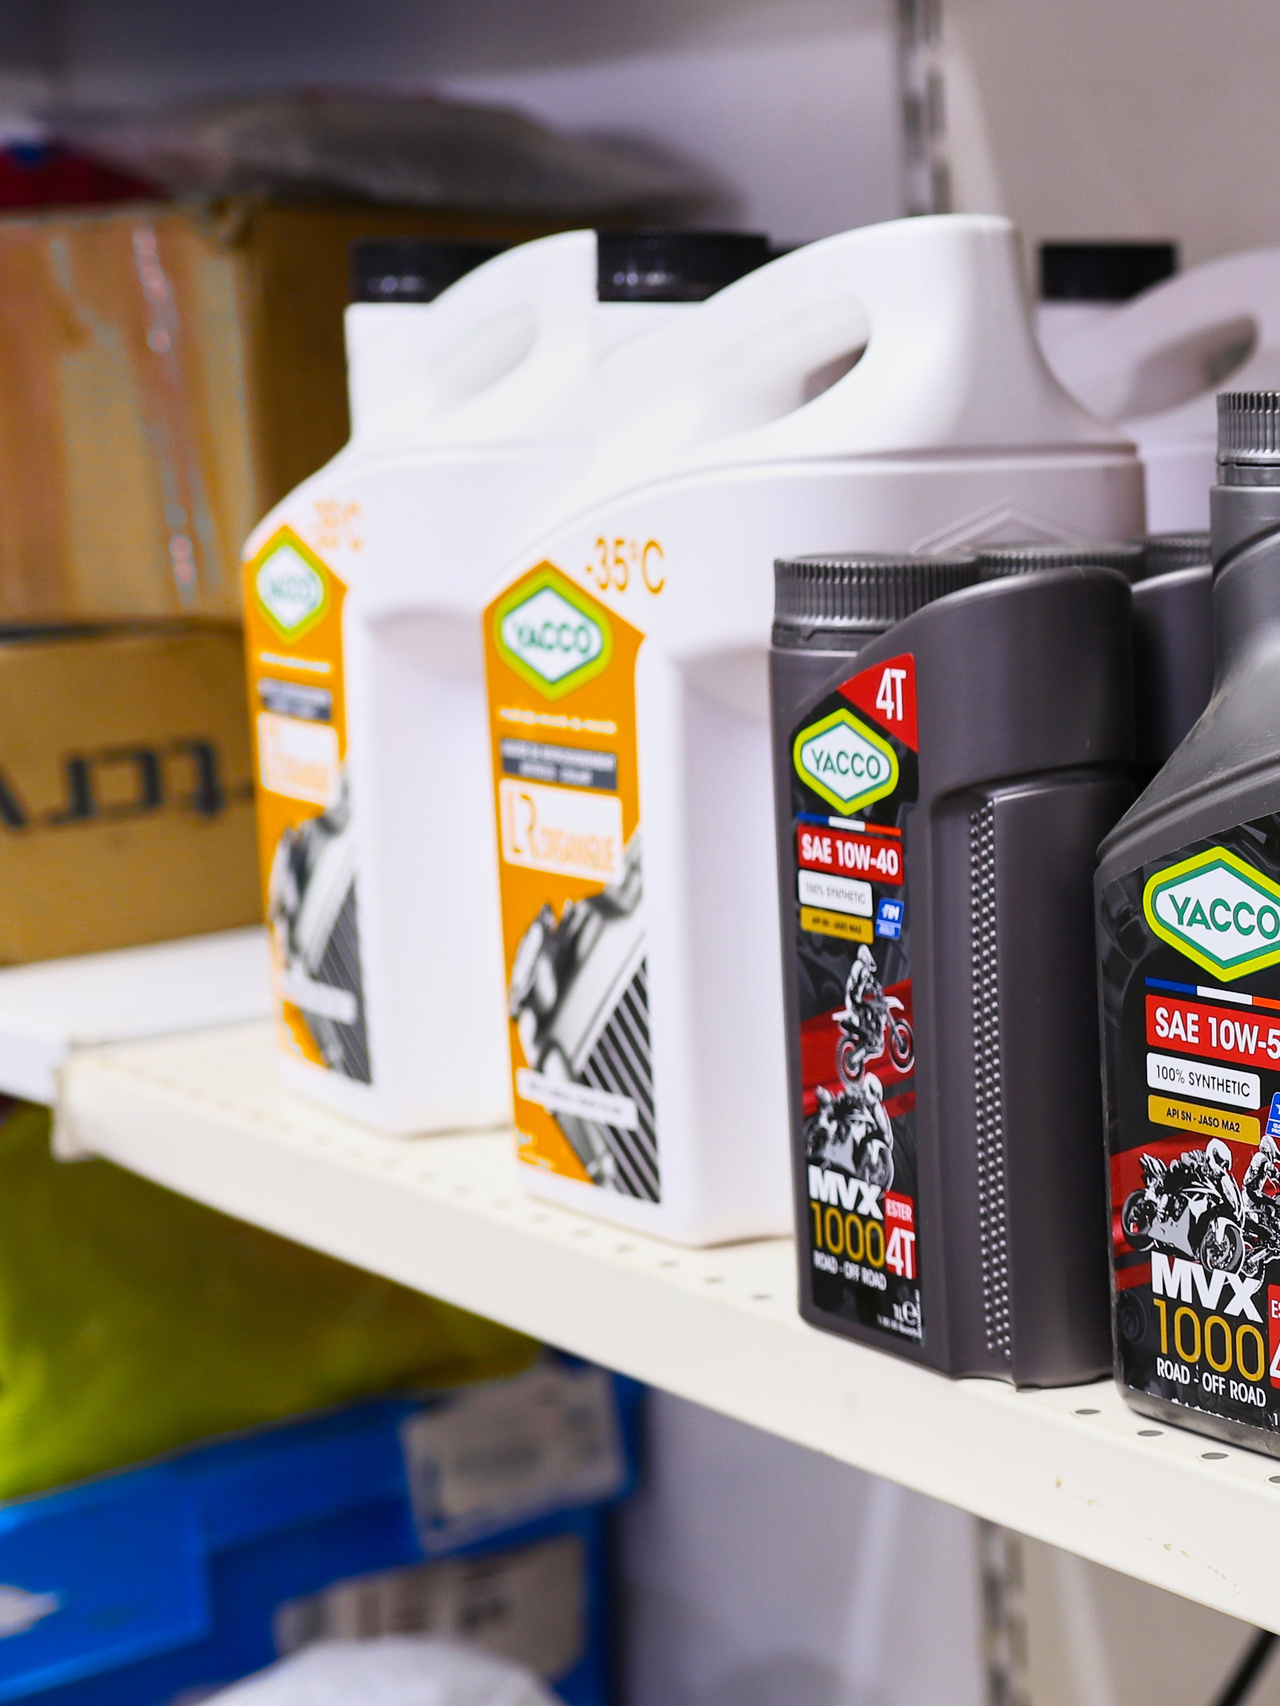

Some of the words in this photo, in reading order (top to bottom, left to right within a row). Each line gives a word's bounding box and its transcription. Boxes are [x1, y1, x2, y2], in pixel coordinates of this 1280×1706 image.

[875, 667, 907, 721] 4T
[810, 747, 881, 780] YACCO
[801, 833, 832, 864] SAE
[836, 841, 899, 876] 10W-40
[826, 886, 866, 905] SYNTHETIC
[1168, 893, 1280, 940] YACCO
[1154, 1006, 1199, 1045] SAE
[1156, 1064, 1185, 1084] 100%
[1188, 1071, 1251, 1097] SYNTHETIC
[1166, 1107, 1180, 1119] API
[1181, 1110, 1192, 1122] SN
[1198, 1114, 1220, 1128] JASO
[1221, 1119, 1241, 1133] MA2
[808, 1164, 884, 1221] MVX
[885, 1198, 913, 1223] ESTER
[810, 1201, 885, 1269] 1000
[885, 1227, 916, 1280] 4T
[813, 1250, 838, 1275] ROAD
[843, 1260, 861, 1283] OFF
[861, 1268, 887, 1291] ROAD
[1151, 1251, 1264, 1323] MVX
[1153, 1298, 1266, 1383] 1000
[1156, 1356, 1191, 1386] ROAD
[1202, 1374, 1227, 1399] OFF
[1229, 1379, 1267, 1408] ROAD
